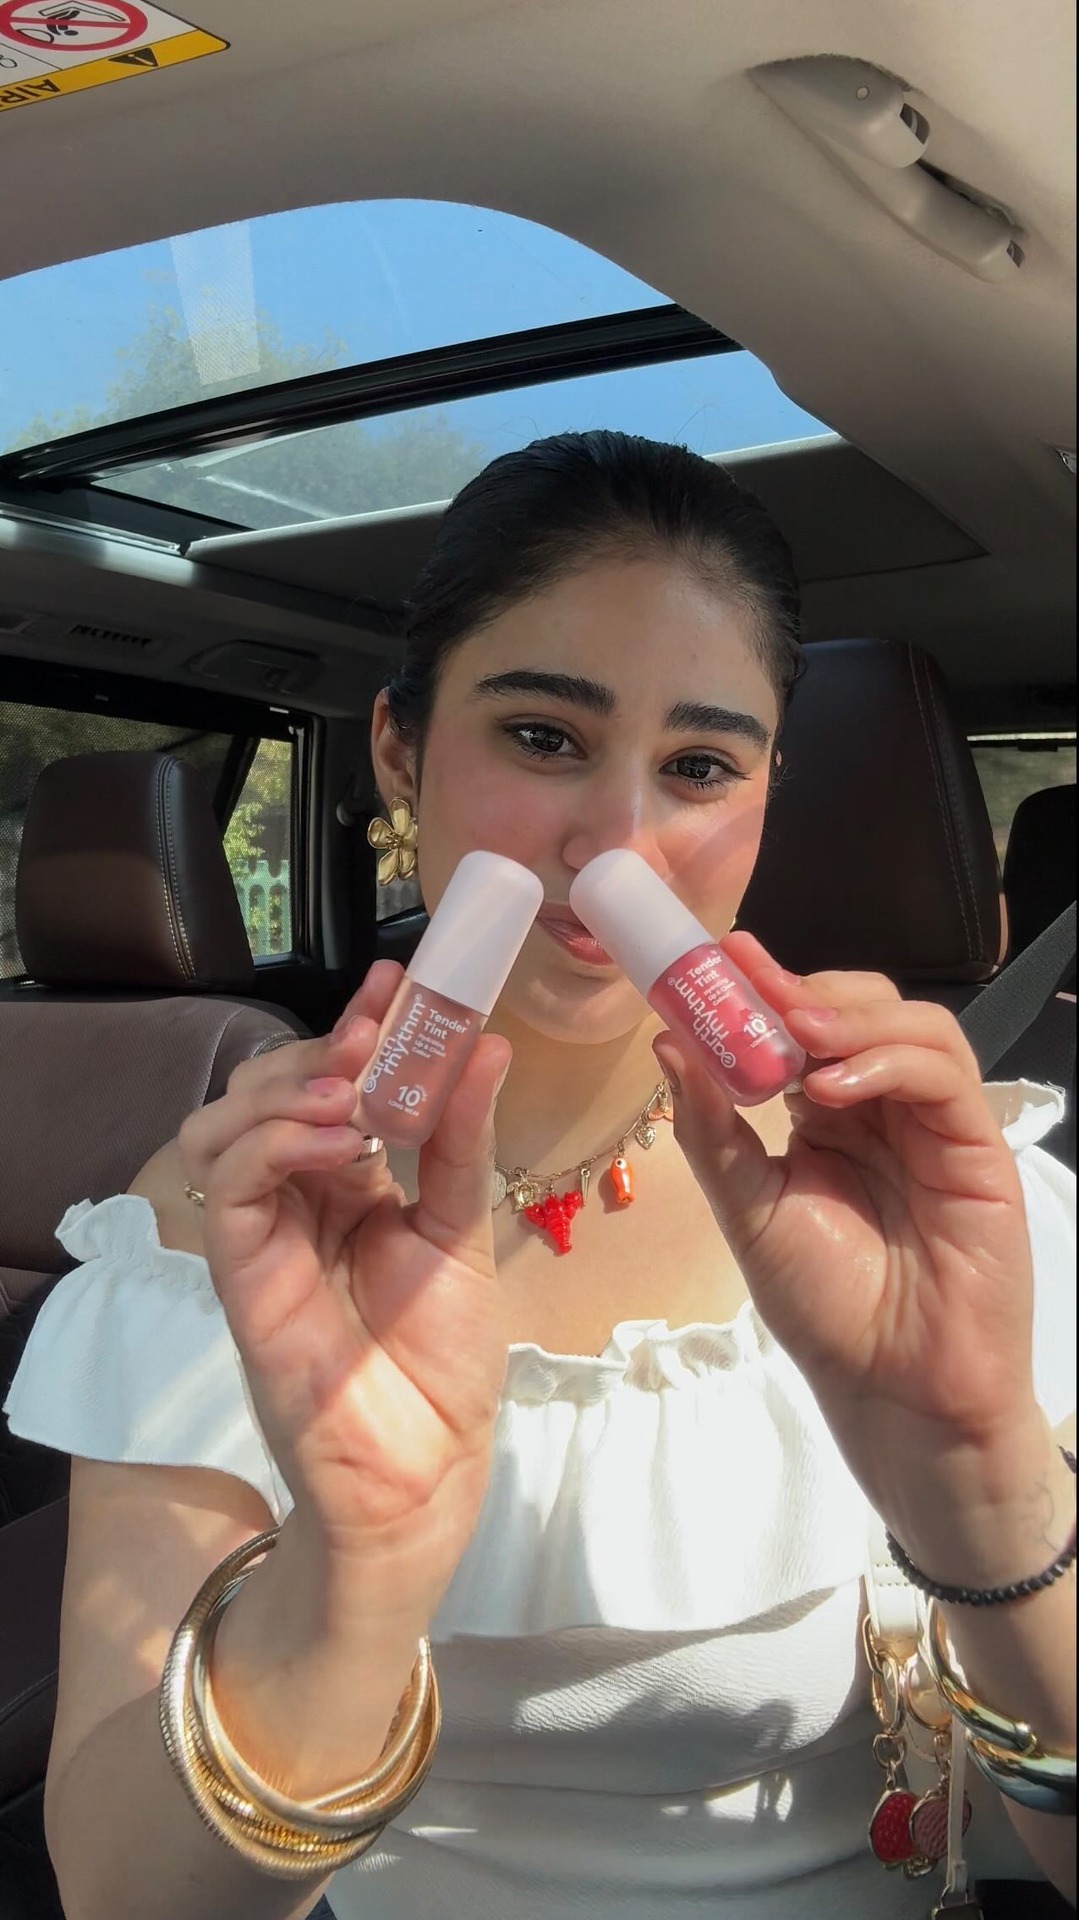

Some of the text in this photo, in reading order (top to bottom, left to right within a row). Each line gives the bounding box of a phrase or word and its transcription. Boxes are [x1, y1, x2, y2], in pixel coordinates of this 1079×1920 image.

[0, 79, 61, 108] AIR
[686, 955, 722, 979] Tender
[694, 970, 720, 988] Tint
[674, 978, 730, 1040] rhythm
[423, 1021, 449, 1040] Tint
[429, 1009, 468, 1034] Tender
[743, 1020, 767, 1038] 10
[384, 1002, 427, 1076] rhythm
[693, 1016, 736, 1069] earth
[398, 1085, 421, 1107] 10
